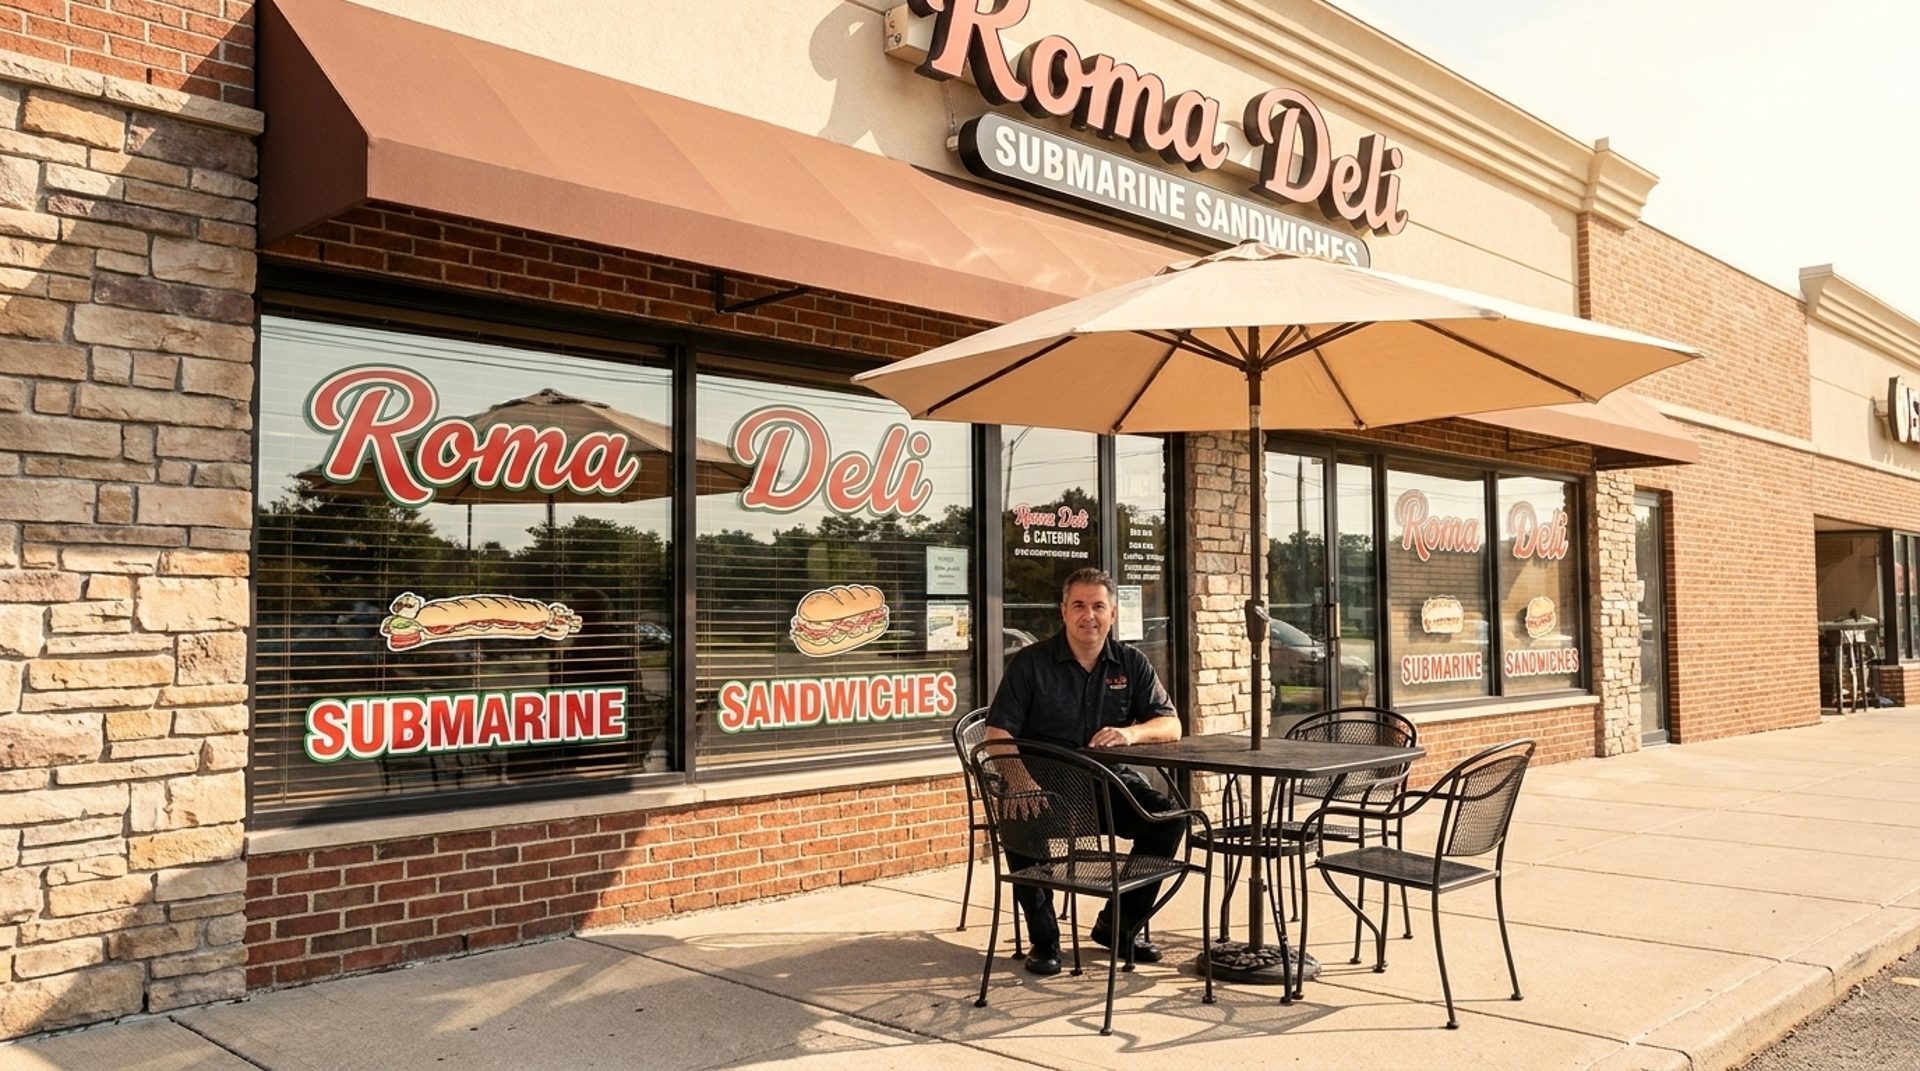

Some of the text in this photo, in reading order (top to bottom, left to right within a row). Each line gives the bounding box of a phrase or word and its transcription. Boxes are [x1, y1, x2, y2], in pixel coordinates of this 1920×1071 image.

[916, 0, 1408, 236] Roma Deli
[995, 126, 1359, 266] SUBMARINE SANDWICHES
[304, 363, 934, 517] Roma Deli
[1395, 489, 1568, 562] Roma Deli
[304, 670, 958, 763] SUBMARINE SANDWICHES
[1401, 652, 1482, 685] SUBMARINE
